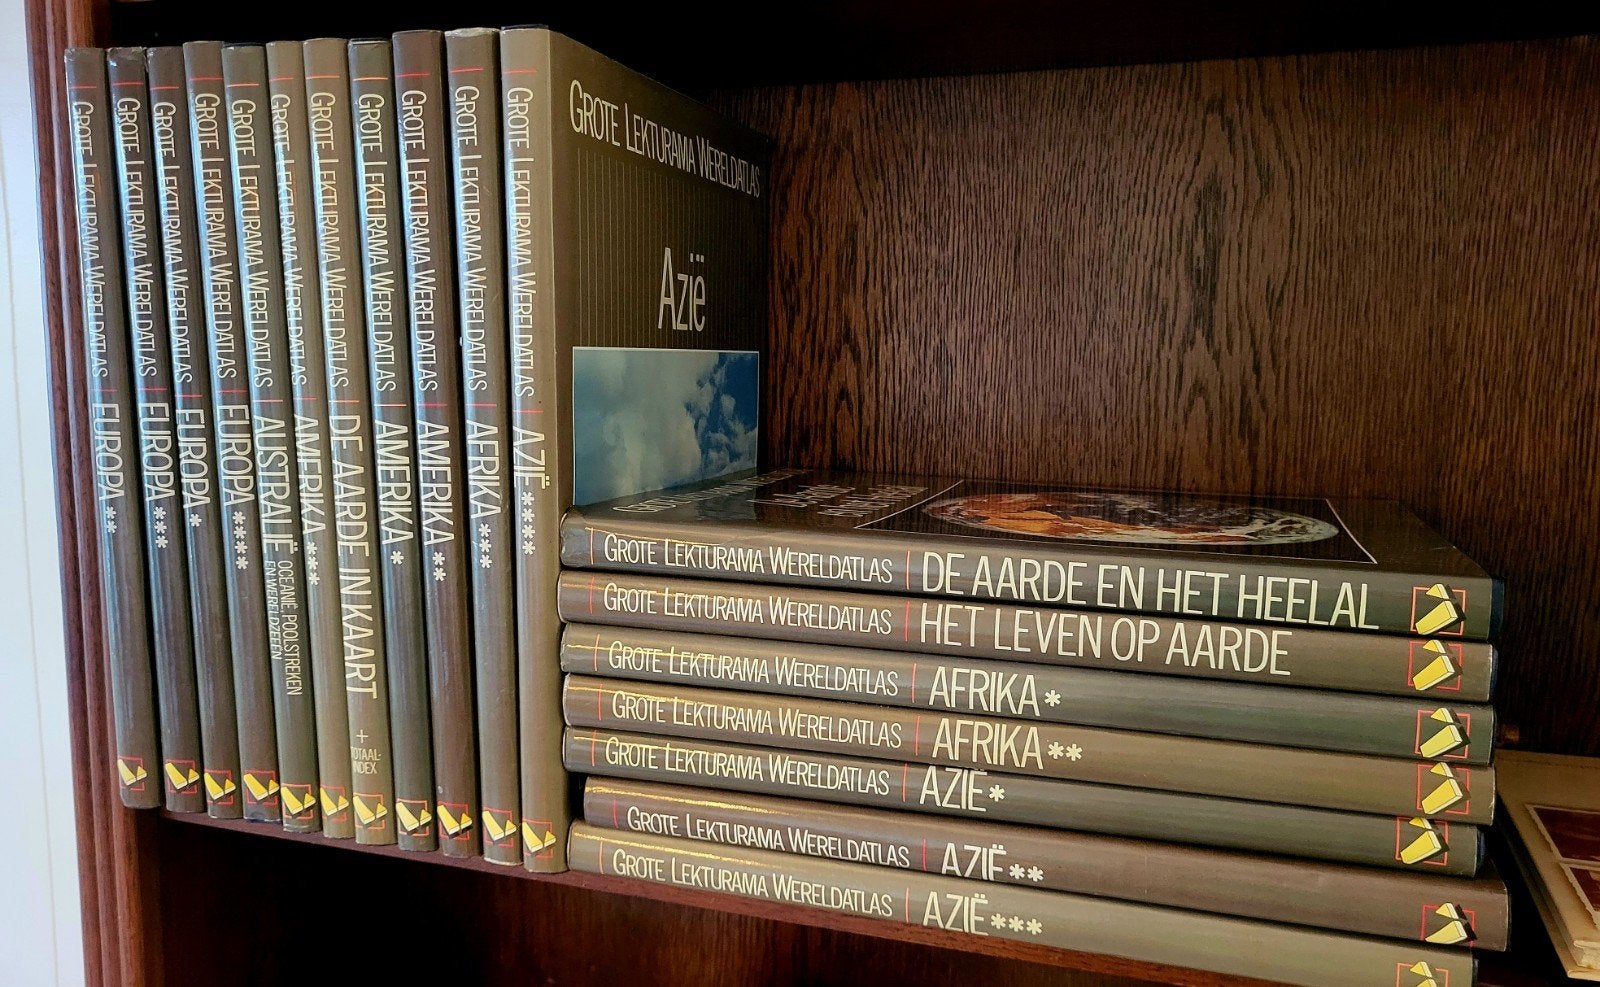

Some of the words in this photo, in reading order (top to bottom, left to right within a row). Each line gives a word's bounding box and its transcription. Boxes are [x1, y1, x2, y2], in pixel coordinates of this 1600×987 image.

[74, 102, 93, 156] GROTE
[117, 97, 140, 153] GROTE
[154, 102, 176, 157] GROTE
[195, 93, 220, 149] GROTE
[232, 99, 256, 156] GROTE
[271, 94, 290, 151] GROTE
[311, 92, 336, 150] GROTE
[358, 93, 384, 152] GROTE
[401, 90, 427, 150] GROTE
[455, 85, 480, 147] GROTE
[507, 87, 533, 148] GROTE
[569, 79, 620, 147] GROTE
[624, 102, 696, 175] LEKTURAMA
[696, 135, 760, 198] WERELDATLAS
[79, 164, 99, 262] LEKTURAMA
[124, 161, 147, 260] LEKTURAMA
[159, 166, 182, 266] LEKTURAMA
[201, 158, 227, 261] LEKTURAMA
[238, 165, 263, 270] LEKTURAMA
[275, 160, 297, 267] LEKTURAMA
[317, 159, 341, 263] LEKTURAMA
[363, 161, 389, 267] LEKTURAMA
[406, 158, 431, 266] LEKTURAMA
[458, 154, 482, 263] LEKTURAMA
[509, 157, 534, 268] LEKTURAMA
[86, 266, 108, 378] WERELDATLAS
[132, 263, 156, 377] WERELDATLAS
[167, 269, 192, 383] WERELDATLAS
[210, 263, 236, 378] WERELDATLAS
[247, 271, 272, 388] WERELDATLAS
[285, 268, 307, 385] WERELDATLAS
[323, 268, 348, 387] WERELDATLAS
[370, 271, 396, 391] WERELDATLAS
[412, 269, 438, 391] WERELDATLAS
[463, 268, 487, 391] WERELDATLAS
[512, 272, 536, 397] WERELDATLAS
[658, 247, 706, 331] Azië
[329, 415, 363, 452] DE
[254, 415, 298, 554] AUSTRALIË
[332, 459, 369, 557] AARDE
[265, 561, 276, 576] EN
[338, 568, 372, 595] IN
[604, 533, 658, 565] GROTE
[664, 538, 765, 574] LEKTURAMA
[769, 546, 893, 583] WERELDATLAS
[922, 551, 964, 595] DE
[972, 555, 1088, 605] AARDE
[1097, 564, 1145, 609] EN
[1156, 568, 1229, 616] HET
[1237, 574, 1380, 629] HEELAL
[282, 614, 302, 695] POOLSTREKEN
[342, 604, 377, 699] KAART
[604, 582, 657, 614] GROTE
[664, 587, 764, 624] LEKTURAMA
[768, 596, 892, 635] WERELDATLAS
[920, 602, 984, 648] HET
[994, 608, 1102, 659] LEVEN
[1111, 617, 1160, 662] OP
[1165, 622, 1293, 676] AARDE
[608, 640, 662, 673] GROTE
[669, 646, 769, 684] LEKTURAMA
[775, 656, 899, 697] WERELDATLAS
[605, 736, 658, 770] GROTE
[665, 742, 764, 782] LEKTURAMA
[768, 753, 890, 796] WERELDATLAS
[612, 690, 665, 724] GROTE
[673, 695, 773, 735] LEKTURAMA
[778, 708, 902, 749] WERELDATLAS
[613, 849, 666, 882] GROTE
[671, 857, 769, 898] LEKTURAMA
[772, 873, 893, 918] WERELDATLAS
[627, 806, 679, 837] GROTE
[686, 813, 785, 852] LEKTURAMA
[788, 829, 910, 869] WERELDATLAS
